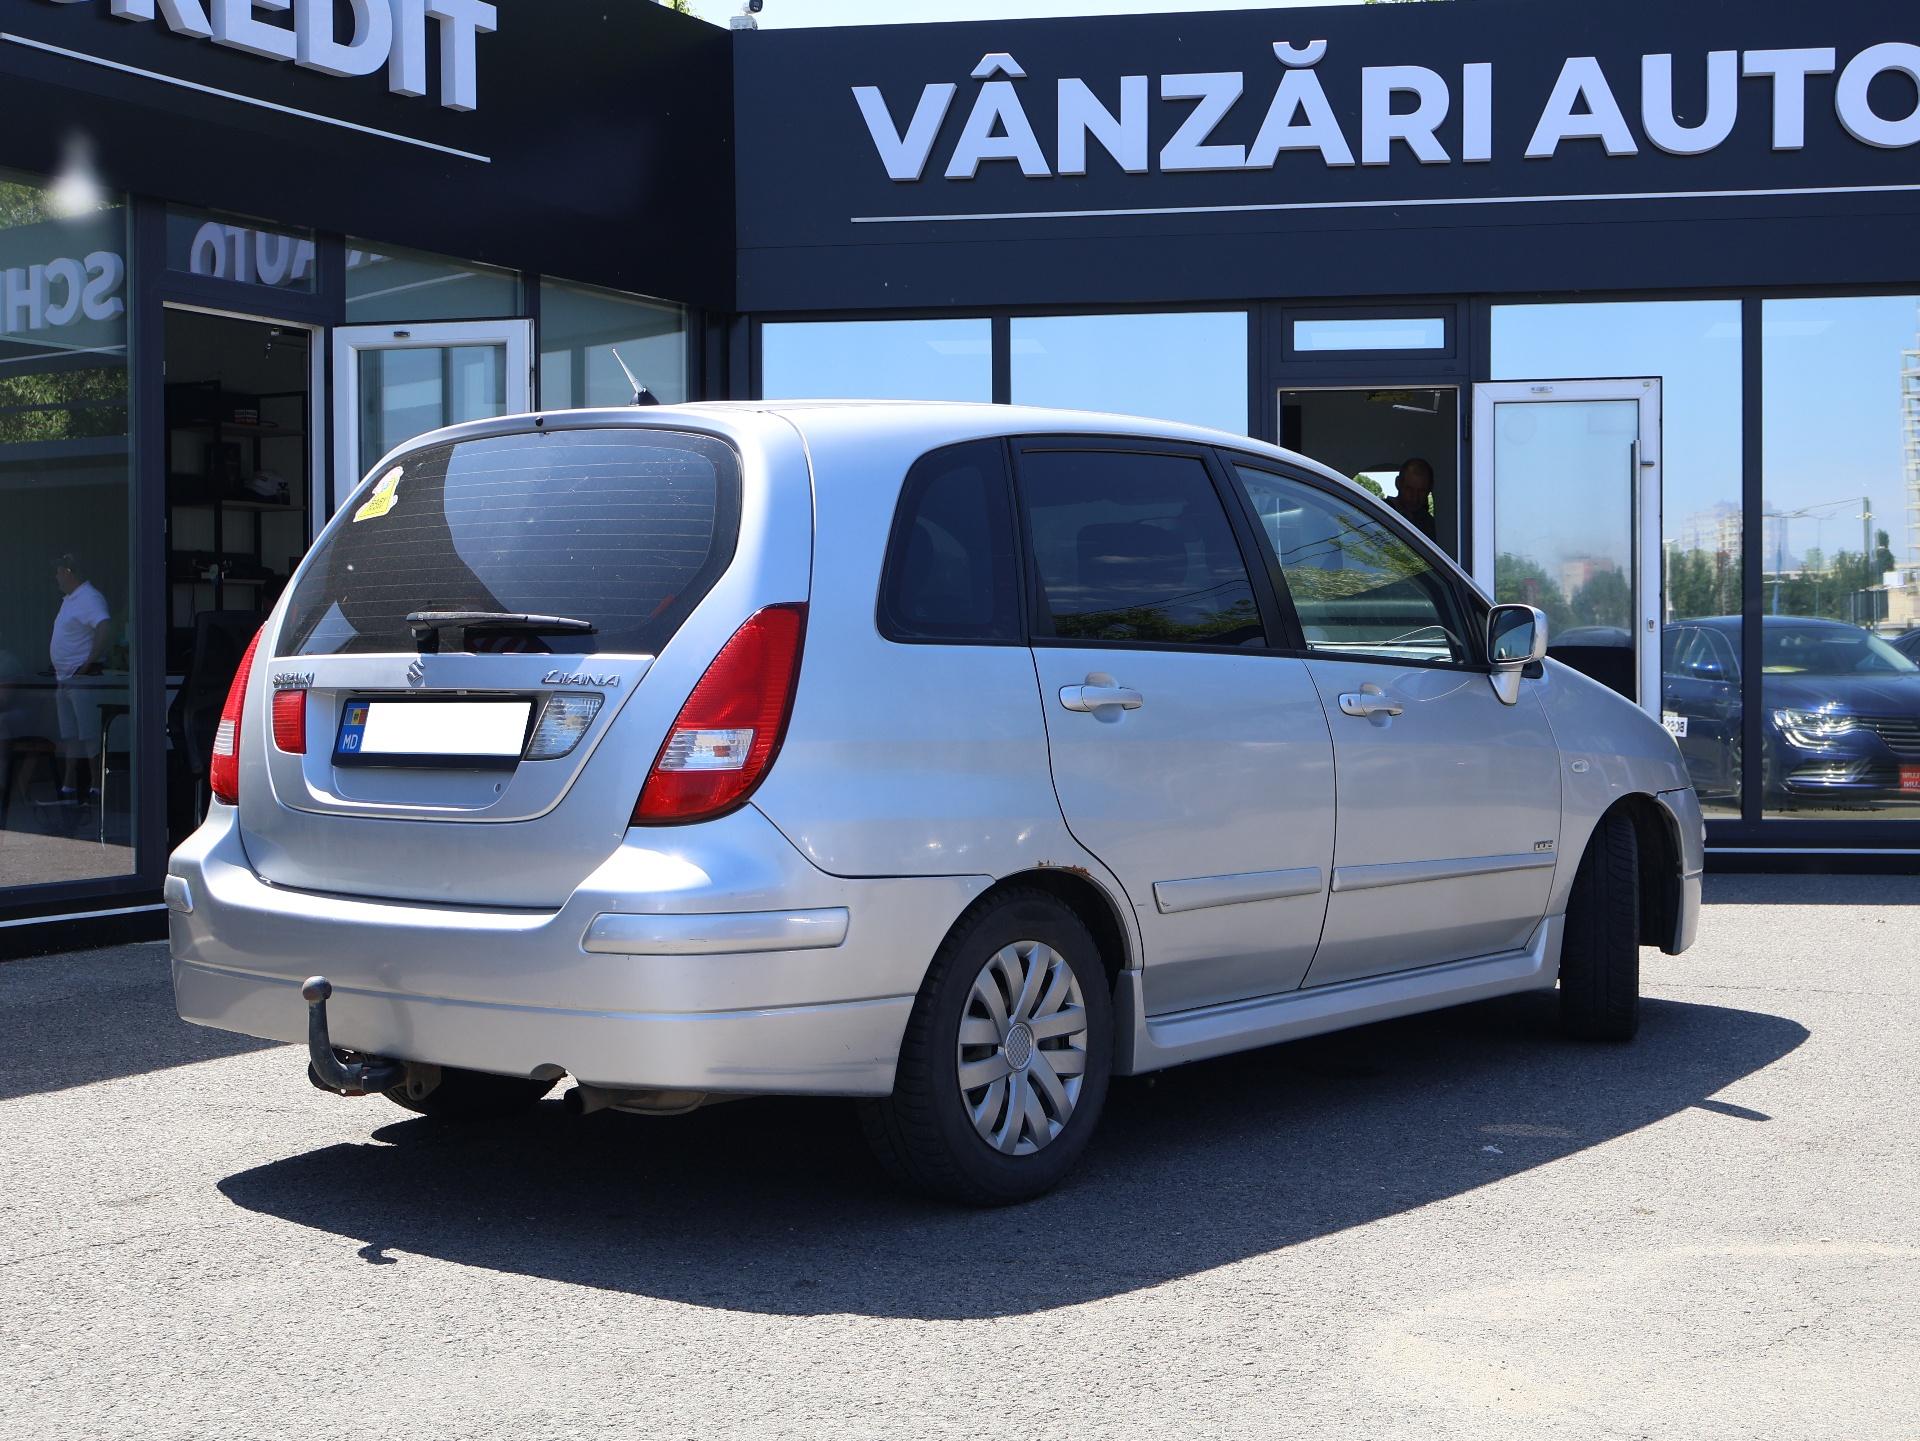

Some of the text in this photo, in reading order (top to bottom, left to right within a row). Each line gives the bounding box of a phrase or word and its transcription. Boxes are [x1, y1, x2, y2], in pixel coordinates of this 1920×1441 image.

[851, 38, 1920, 181] VÂNZĂRI AUTO
[272, 671, 315, 687] SUZUKI
[542, 669, 620, 687] LIANA
[342, 733, 359, 750] MD
